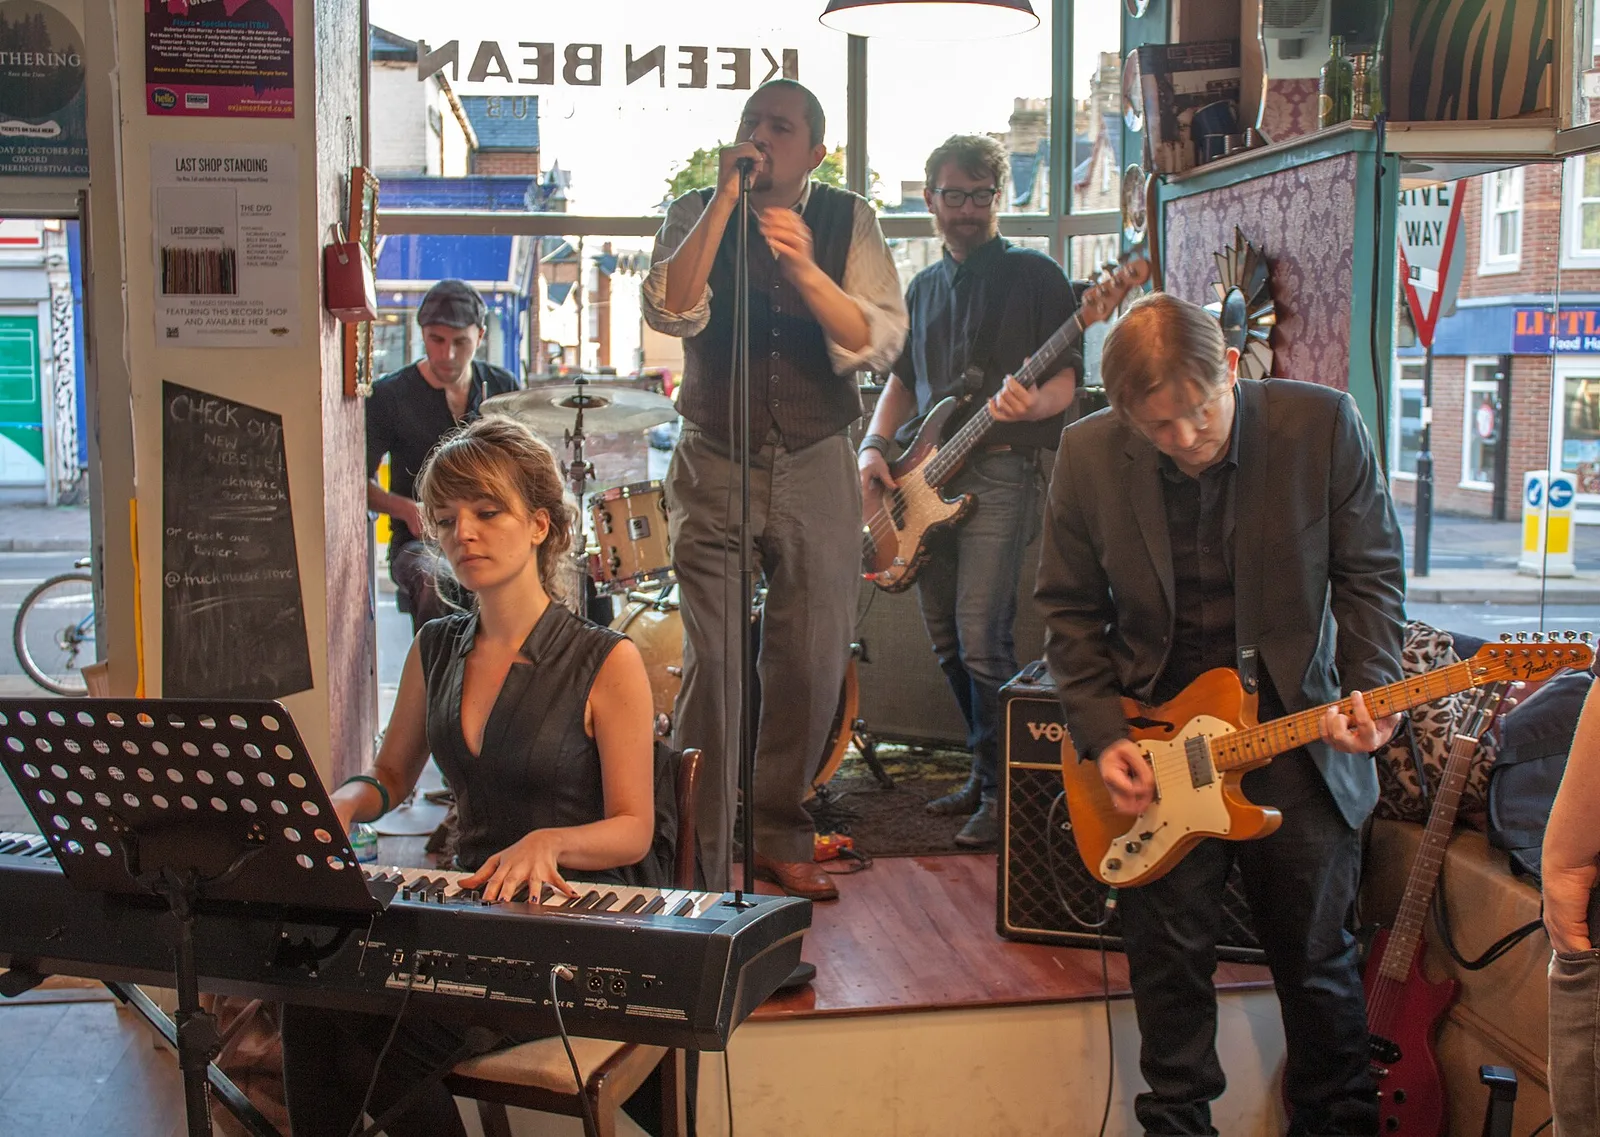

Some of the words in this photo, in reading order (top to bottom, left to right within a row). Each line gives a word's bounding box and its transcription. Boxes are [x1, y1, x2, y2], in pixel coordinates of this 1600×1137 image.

[155, 92, 174, 103] hello
[28, 147, 68, 155] OCTOBER
[12, 155, 48, 163] OXFORD
[175, 158, 197, 172] LAST
[198, 158, 222, 172] SHOP
[224, 158, 268, 172] STANDING
[170, 226, 183, 235] LAST
[184, 227, 198, 235] SHOP
[199, 227, 224, 235] STANDING
[1406, 220, 1442, 246] WAY
[166, 308, 209, 316] FEATURING
[170, 394, 240, 428] CHECK
[204, 432, 238, 450] NEW
[1522, 660, 1553, 678] Fender
[1027, 722, 1067, 742] VO
